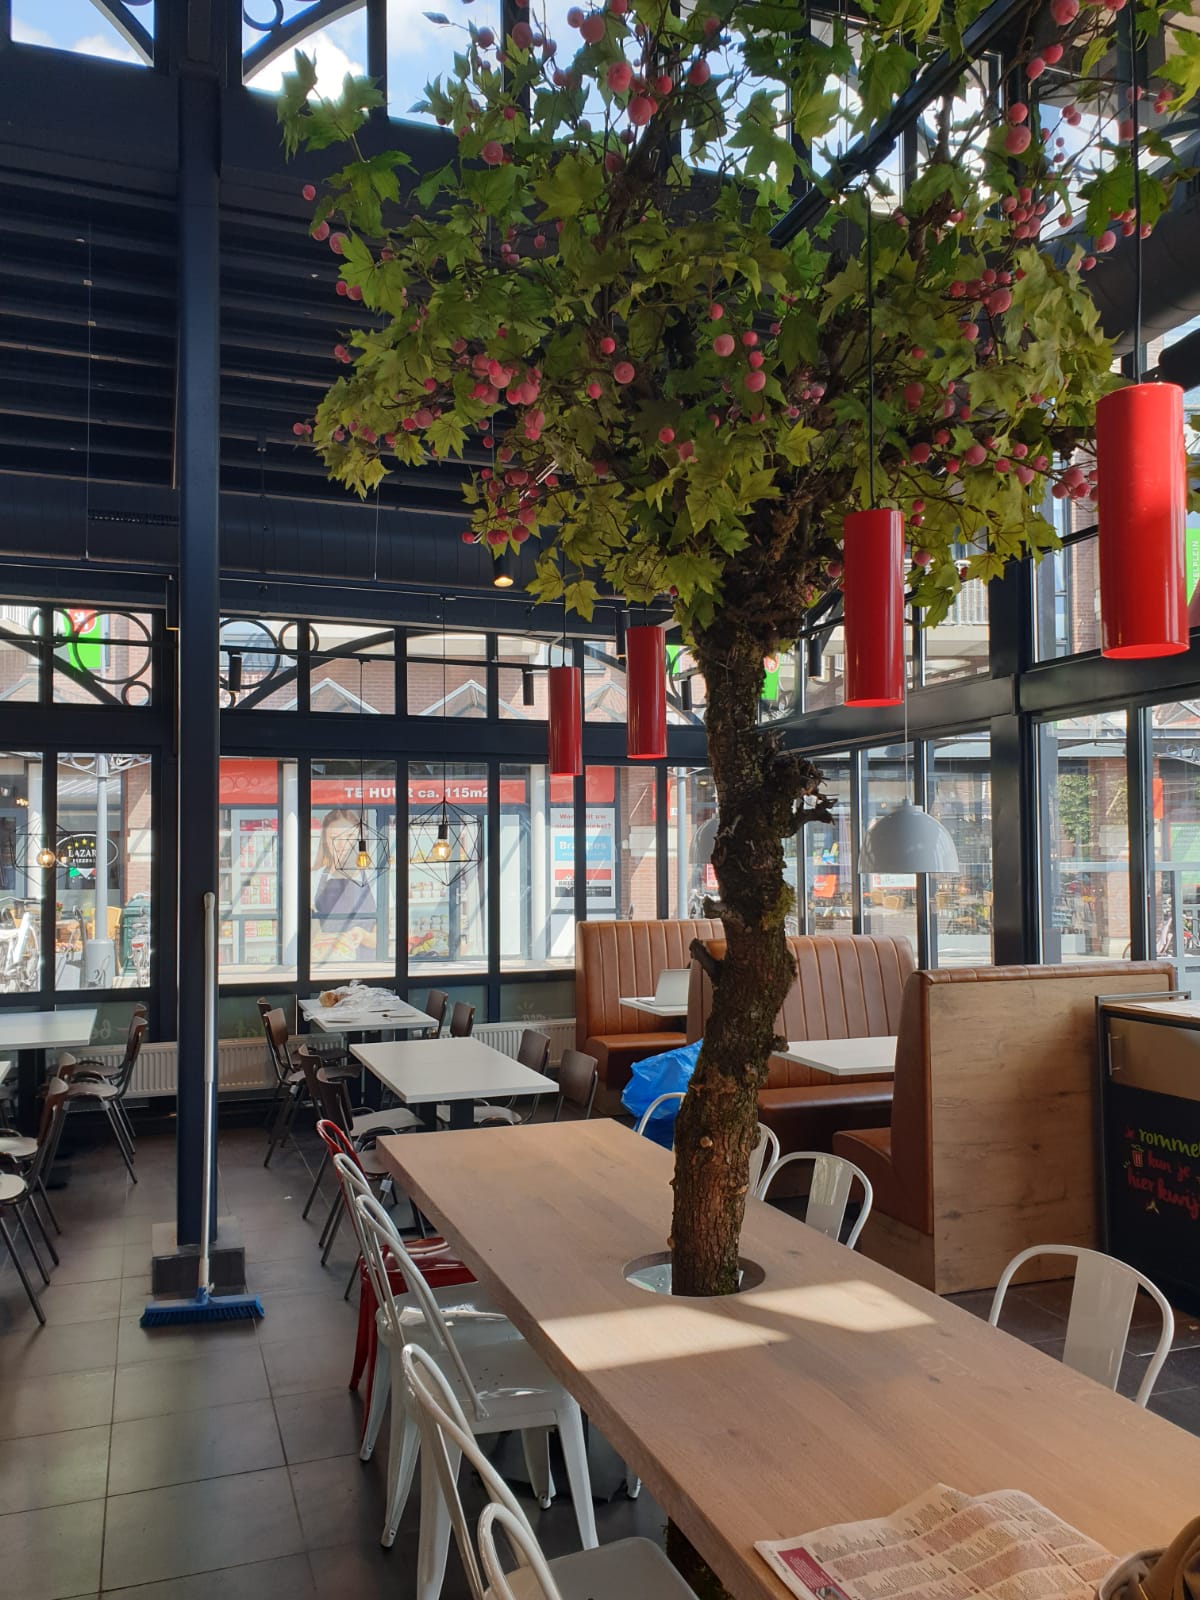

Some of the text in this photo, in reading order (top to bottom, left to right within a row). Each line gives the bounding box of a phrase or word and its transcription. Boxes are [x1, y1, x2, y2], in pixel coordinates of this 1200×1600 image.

[344, 787, 363, 798] TE
[417, 789, 440, 798] ca.
[68, 849, 97, 857] LAZAR
[1138, 1128, 1200, 1158] romme
[1157, 1177, 1200, 1220] kwij
